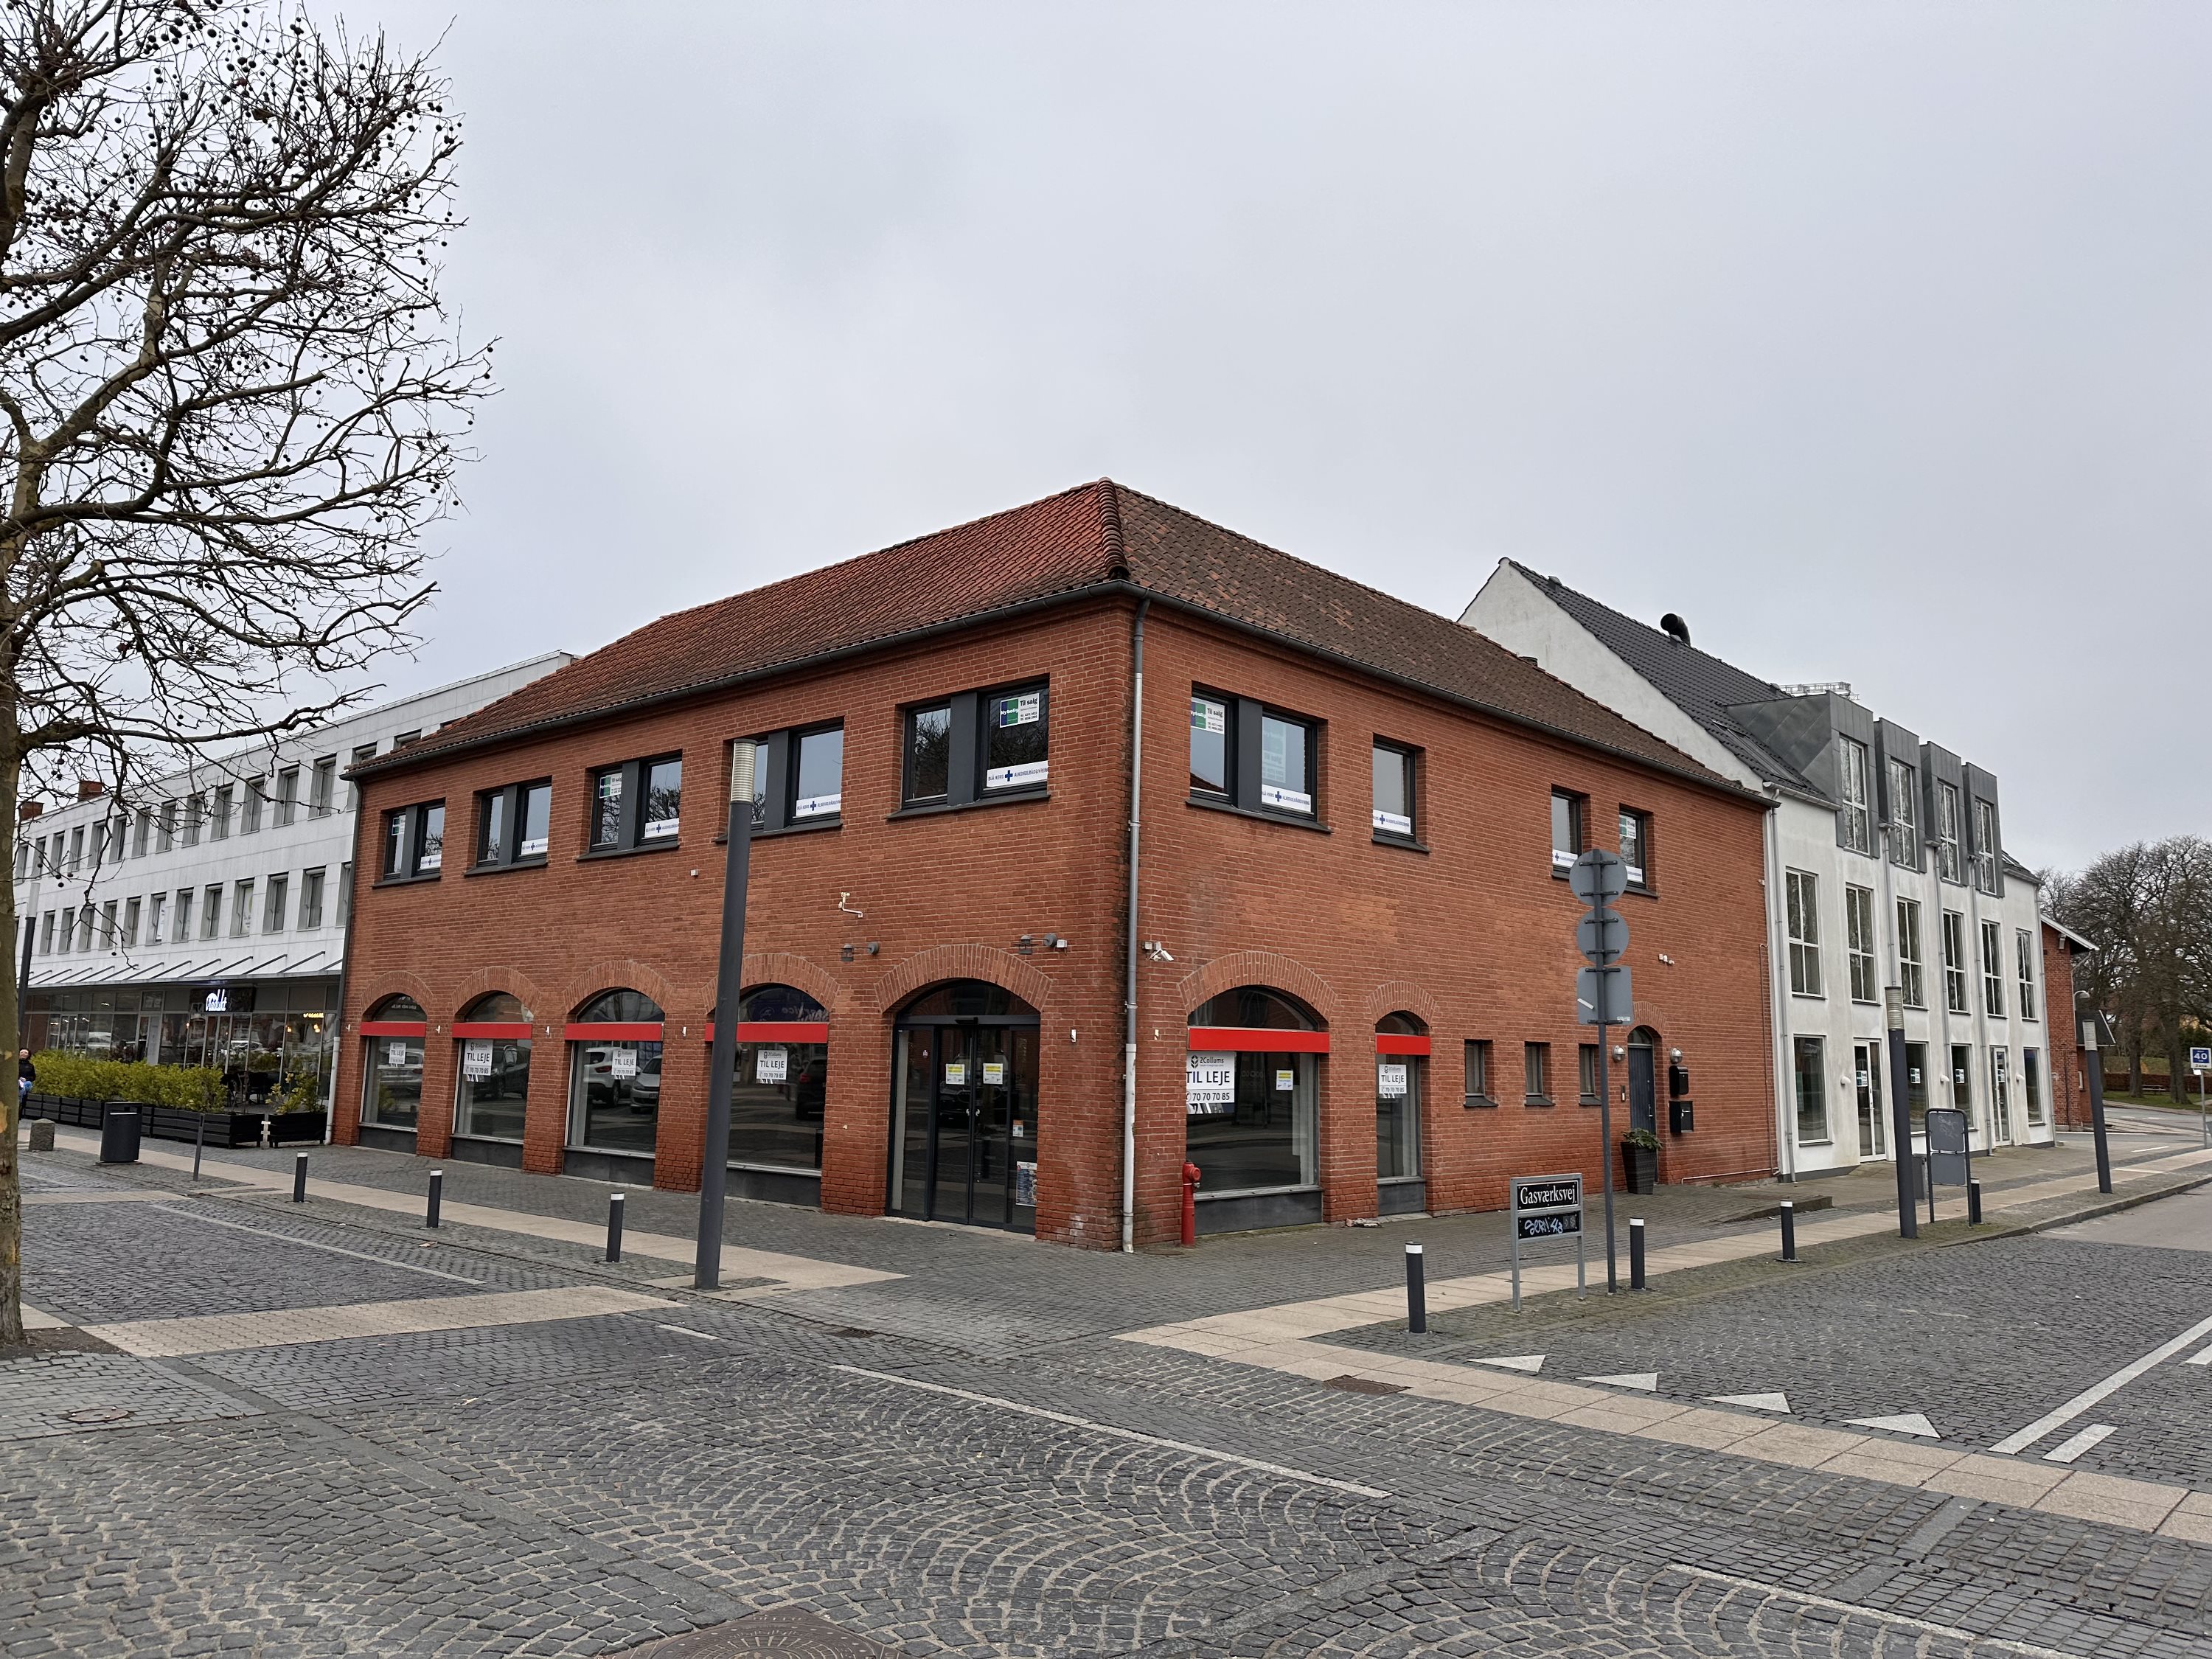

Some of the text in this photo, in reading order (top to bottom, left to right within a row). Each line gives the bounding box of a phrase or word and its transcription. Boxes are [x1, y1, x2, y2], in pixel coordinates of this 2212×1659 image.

[1213, 710, 1223, 718] salg
[467, 1052, 490, 1064] TIL LEJE
[623, 1058, 635, 1067] LEJE
[1200, 1056, 1224, 1064] 2Collums
[760, 1060, 785, 1070] TIL LEJE
[1186, 1071, 1203, 1083] TIL
[1206, 1071, 1230, 1086] LEJE
[1381, 1074, 1405, 1084] TIL LEJE
[1192, 1092, 1230, 1101] 70 70 70 85
[1520, 1185, 1575, 1205] Gasværksvej
